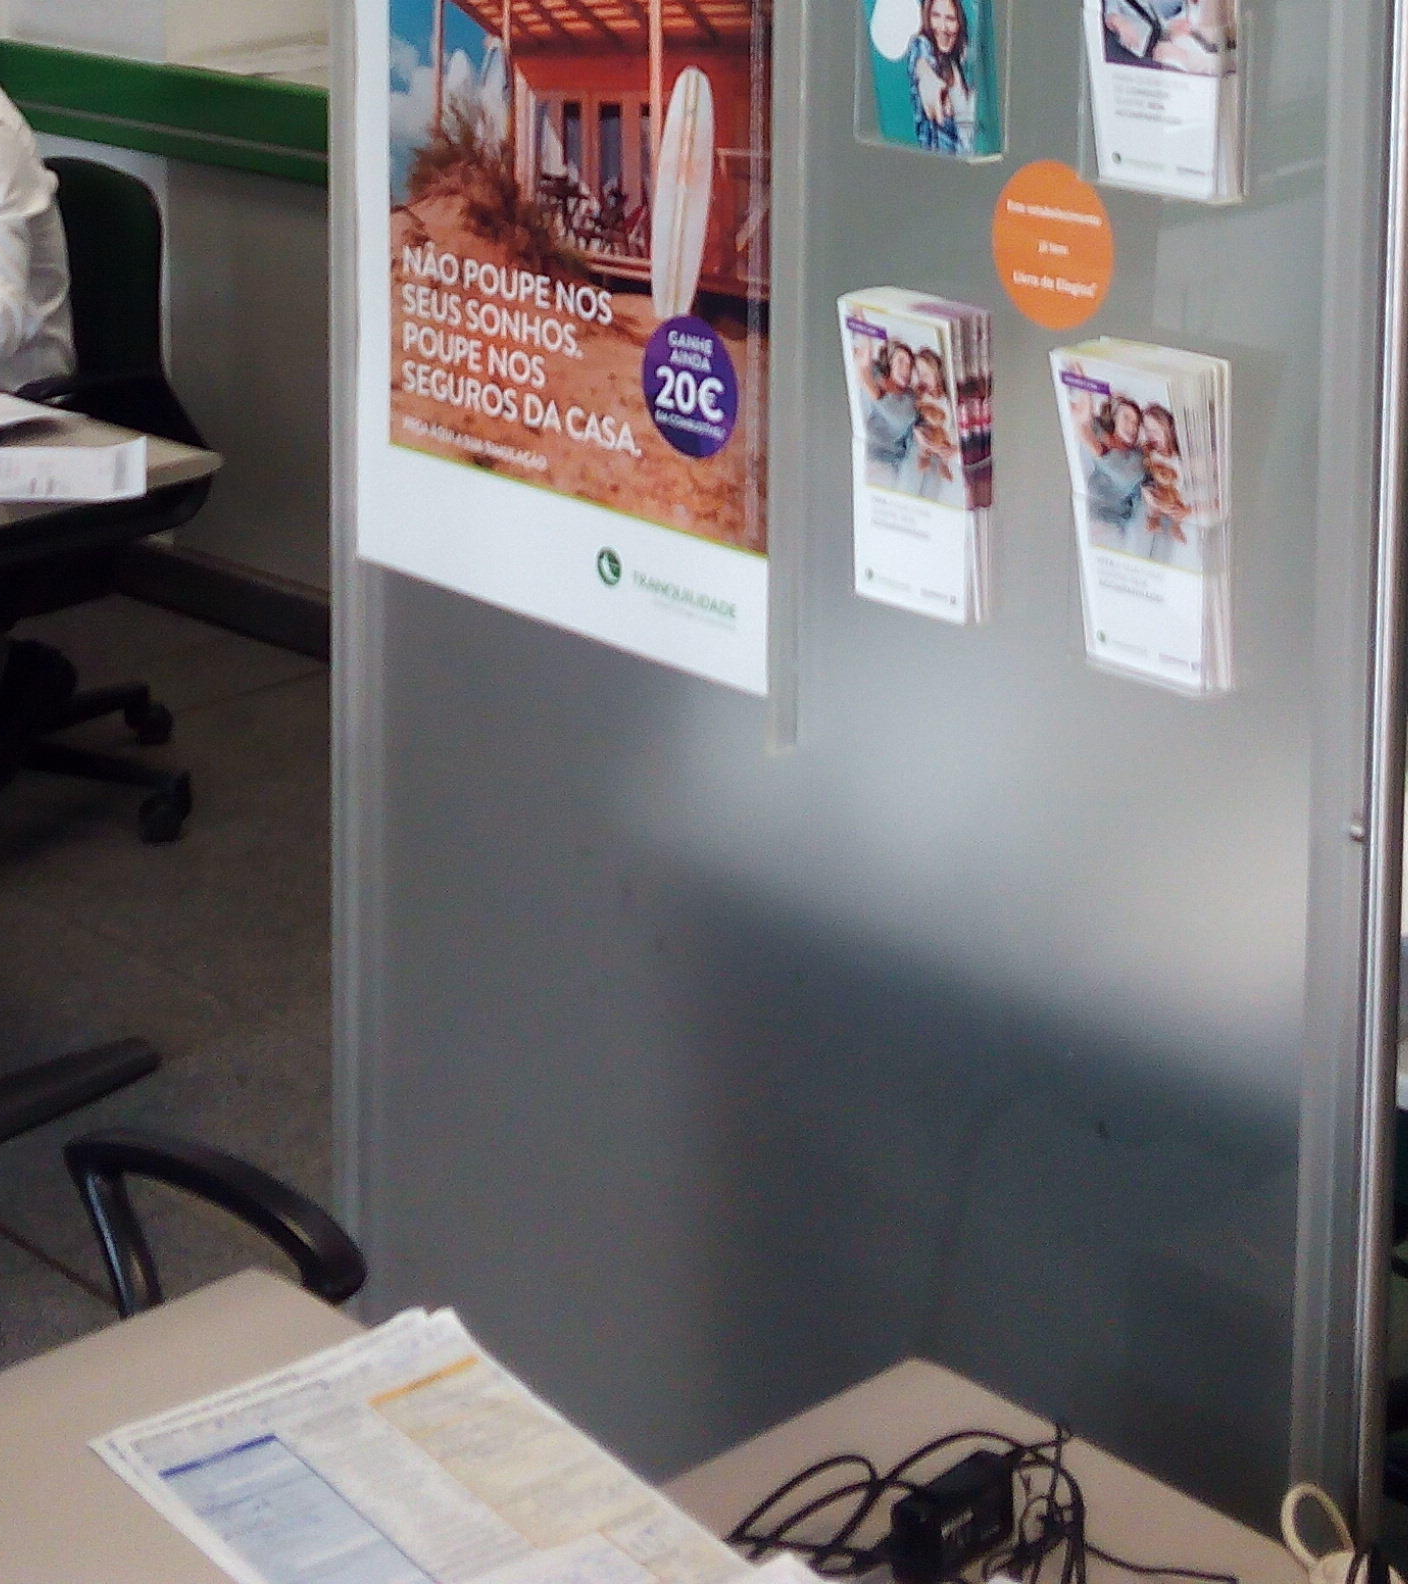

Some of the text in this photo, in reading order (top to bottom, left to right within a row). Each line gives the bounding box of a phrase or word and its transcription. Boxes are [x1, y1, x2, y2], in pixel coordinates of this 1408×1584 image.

[402, 242, 613, 326] NÃO POUPE NOS
[402, 283, 584, 360] SEUS SONHOS.
[402, 321, 546, 389] POUPE NOS
[401, 360, 642, 458] SEGUROS DA CASA.
[654, 365, 725, 423] 20€
